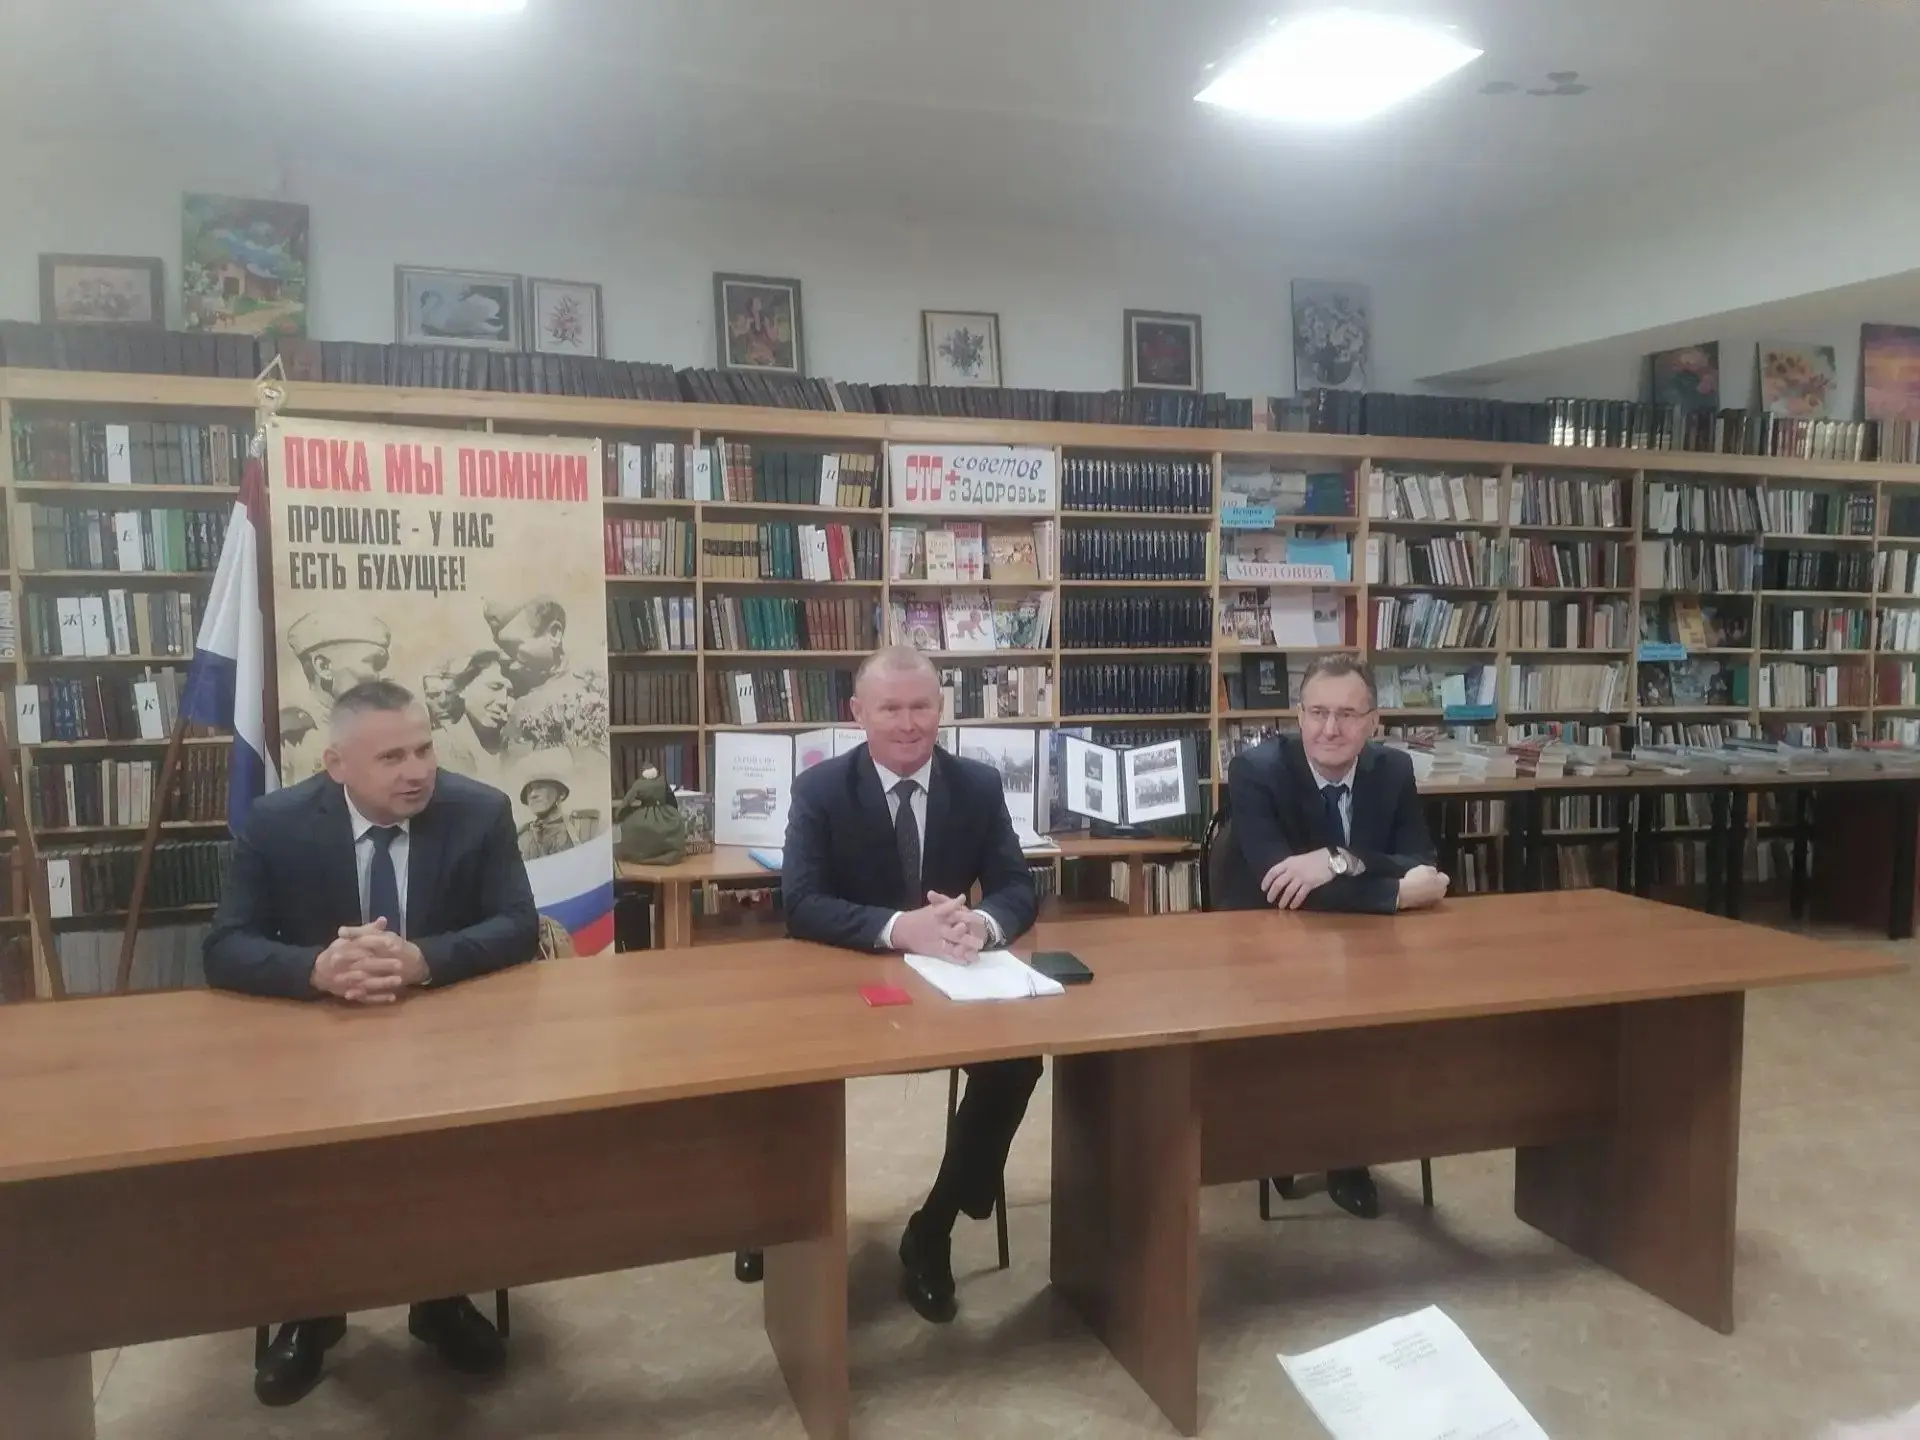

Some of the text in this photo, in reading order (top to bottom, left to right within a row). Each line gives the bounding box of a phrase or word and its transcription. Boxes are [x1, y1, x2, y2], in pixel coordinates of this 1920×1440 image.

[284, 436, 589, 502] ПОКА МЫ ПОМНИМ
[697, 463, 708, 473] Ф
[906, 454, 1042, 501] СТО советов
[287, 504, 401, 546] ПРОШЛОЕ
[428, 509, 442, 547] У
[453, 511, 495, 548] НАС
[289, 552, 467, 597] ЕСТЬ БУДУЩЕЕ!
[63, 614, 79, 626] Ж
[145, 698, 156, 711] К
